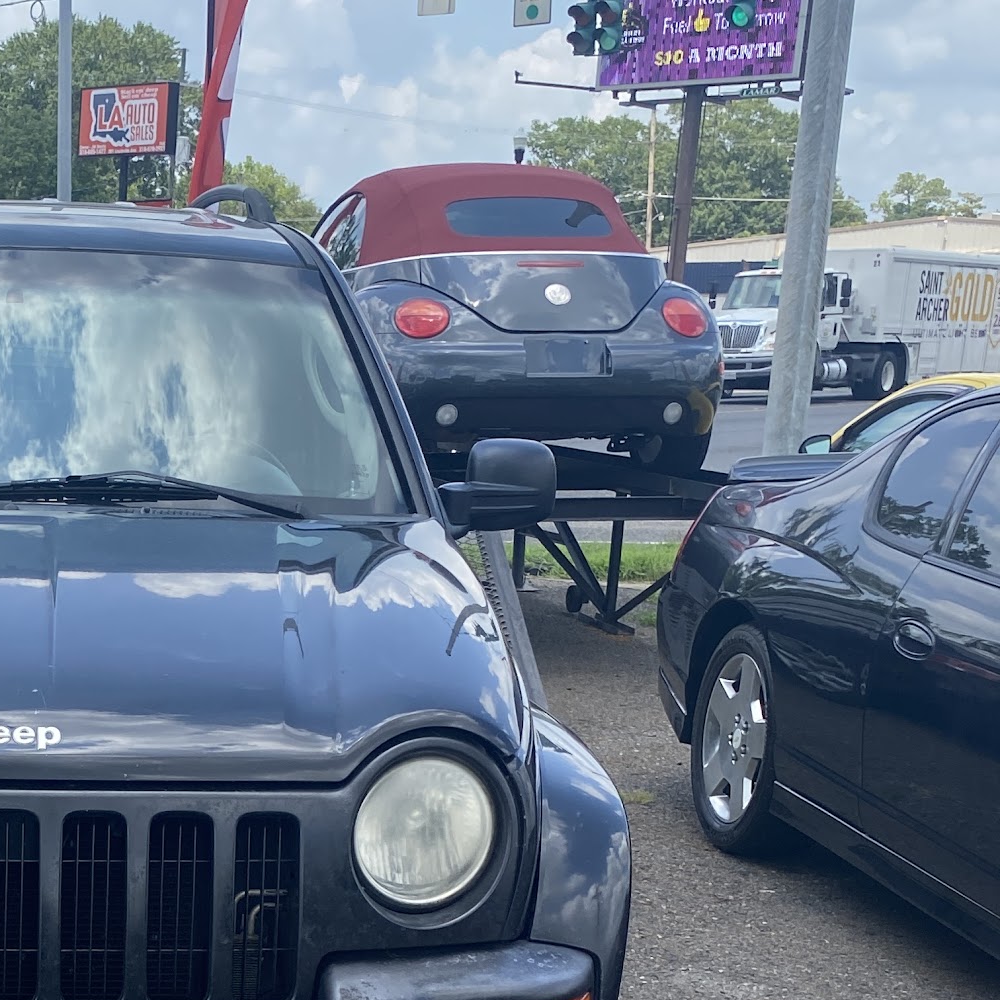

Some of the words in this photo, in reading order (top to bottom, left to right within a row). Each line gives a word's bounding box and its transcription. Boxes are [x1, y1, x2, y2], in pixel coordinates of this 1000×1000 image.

[663, 16, 691, 35] Fuel
[689, 49, 700, 63] A
[706, 42, 782, 63] MONTH
[743, 88, 777, 96] LAMAR
[97, 104, 124, 131] LA
[126, 103, 155, 125] AUTO
[130, 125, 154, 141] SALES
[919, 270, 944, 295] SAINT
[950, 272, 994, 322] GOLD
[915, 297, 950, 321] ARCHER
